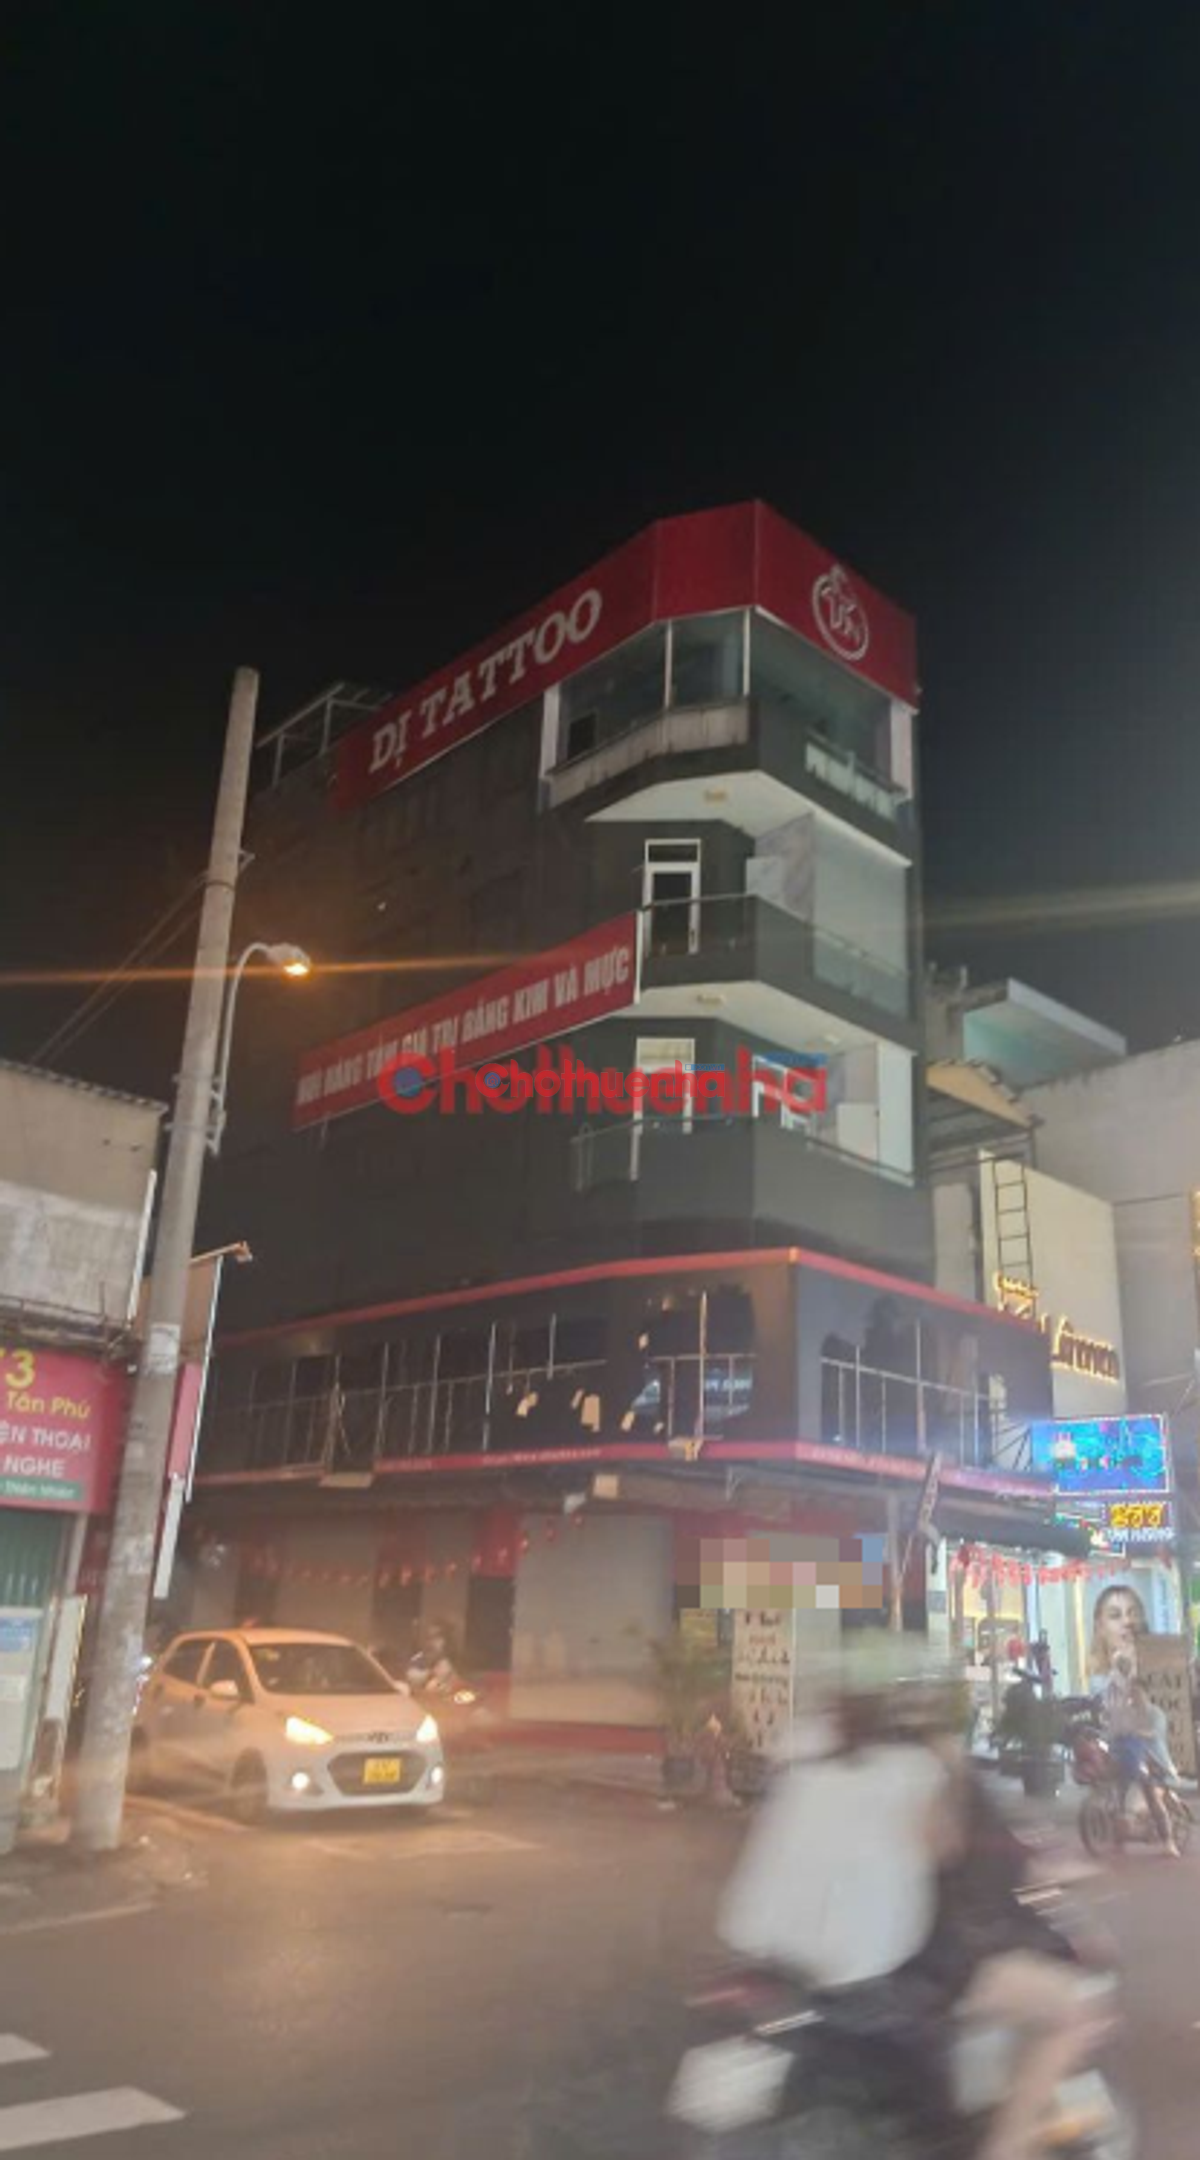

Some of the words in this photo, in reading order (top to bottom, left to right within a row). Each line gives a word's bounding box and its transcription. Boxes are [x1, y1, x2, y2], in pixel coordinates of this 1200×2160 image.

[368, 708, 412, 774] DỊ
[419, 587, 603, 740] TATTOO
[7, 1391, 45, 1415] Tân
[52, 1396, 91, 1420] Phú
[4, 1454, 66, 1479] NGHE
